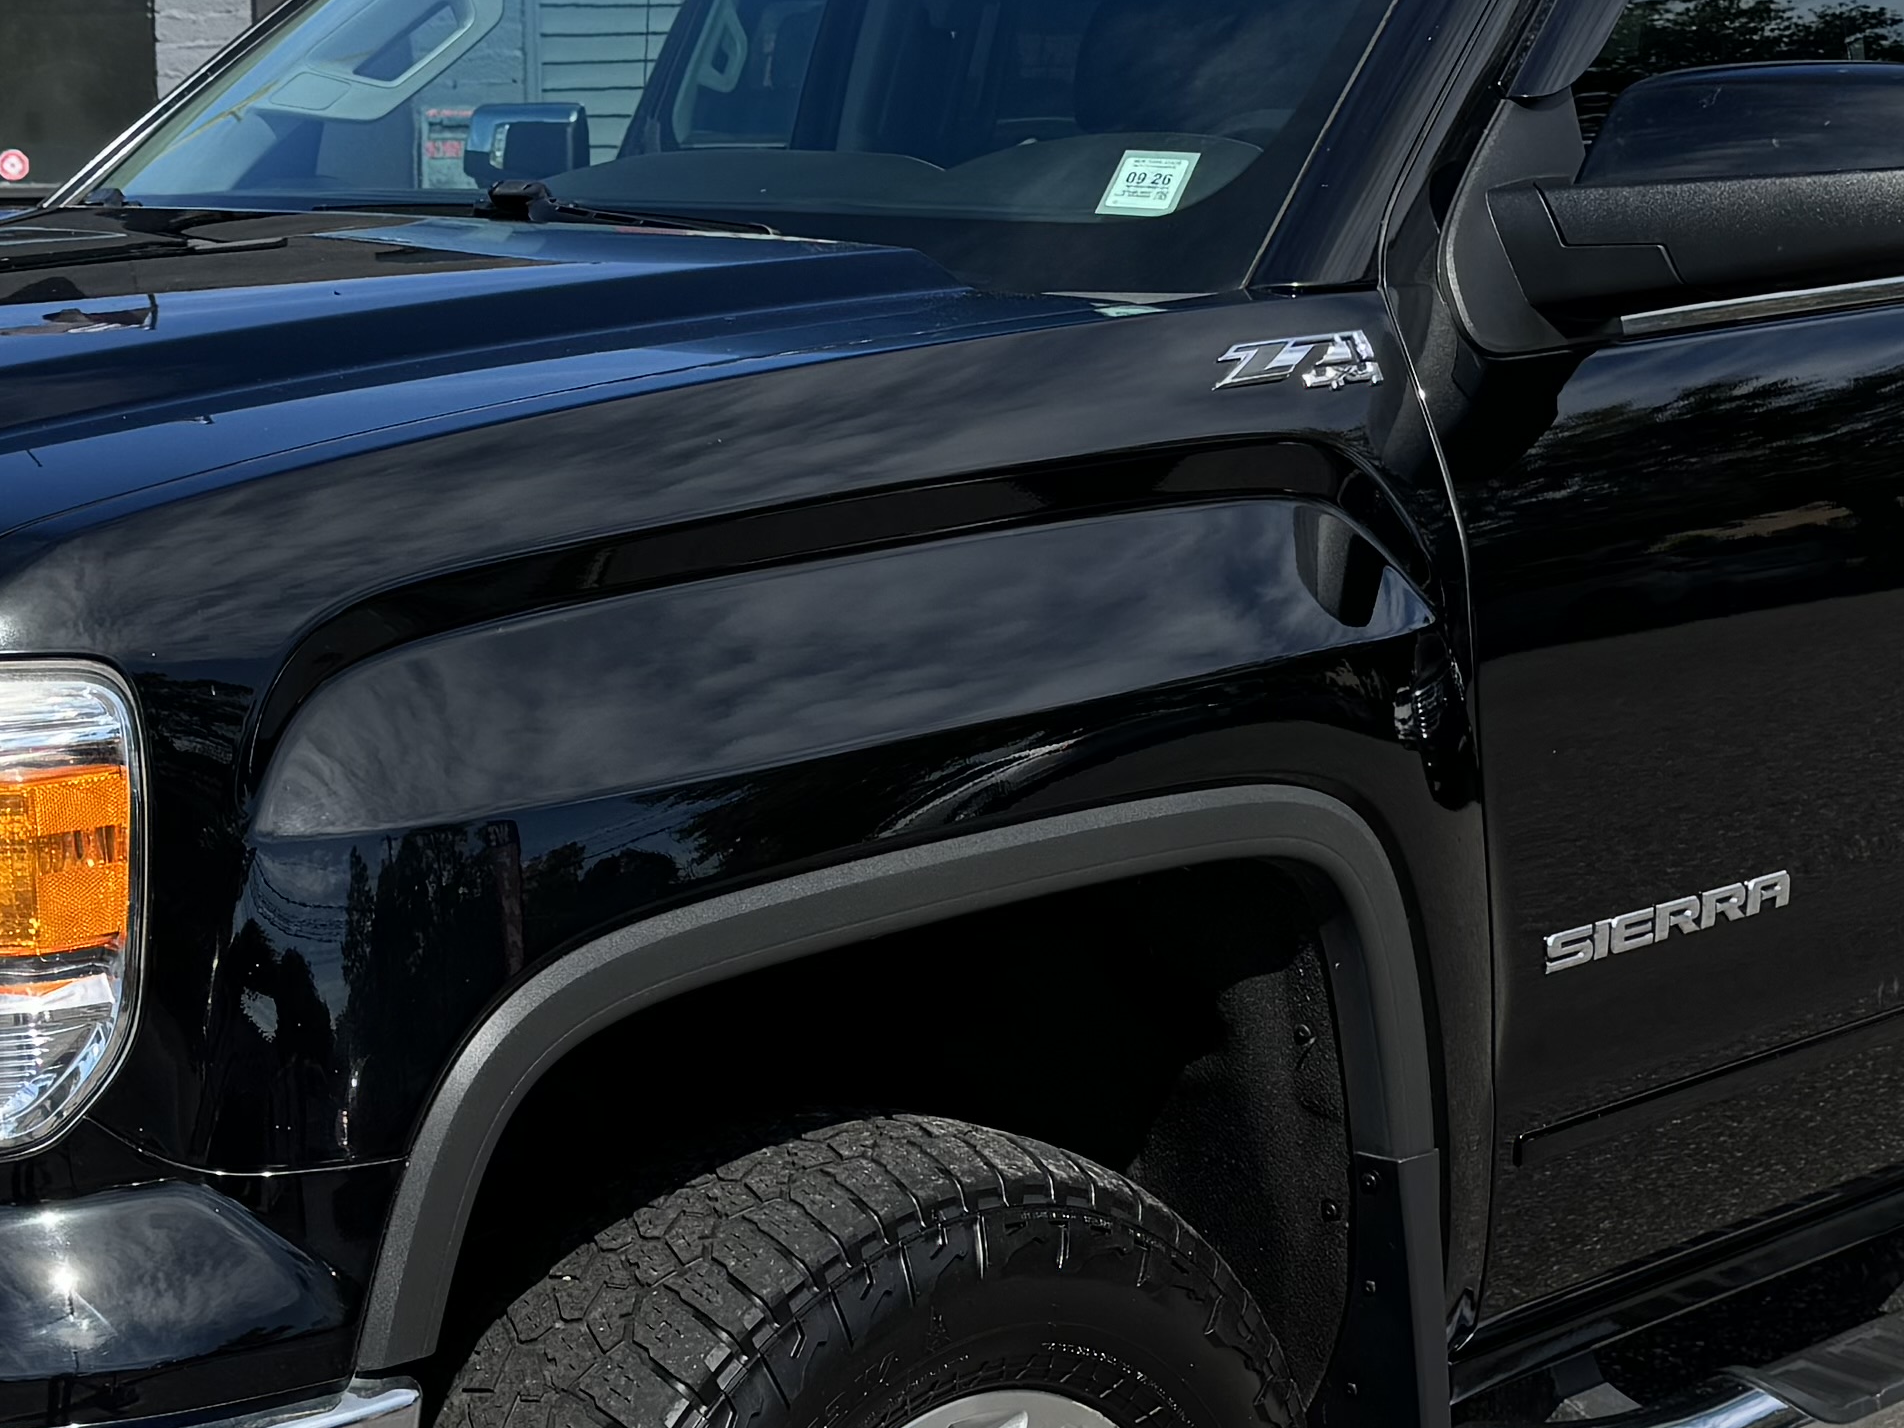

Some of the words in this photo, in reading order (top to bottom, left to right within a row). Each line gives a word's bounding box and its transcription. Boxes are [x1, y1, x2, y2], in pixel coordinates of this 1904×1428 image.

[1126, 171, 1148, 185] 09
[1150, 172, 1174, 186] 26
[1544, 869, 1791, 975] SIERRA
